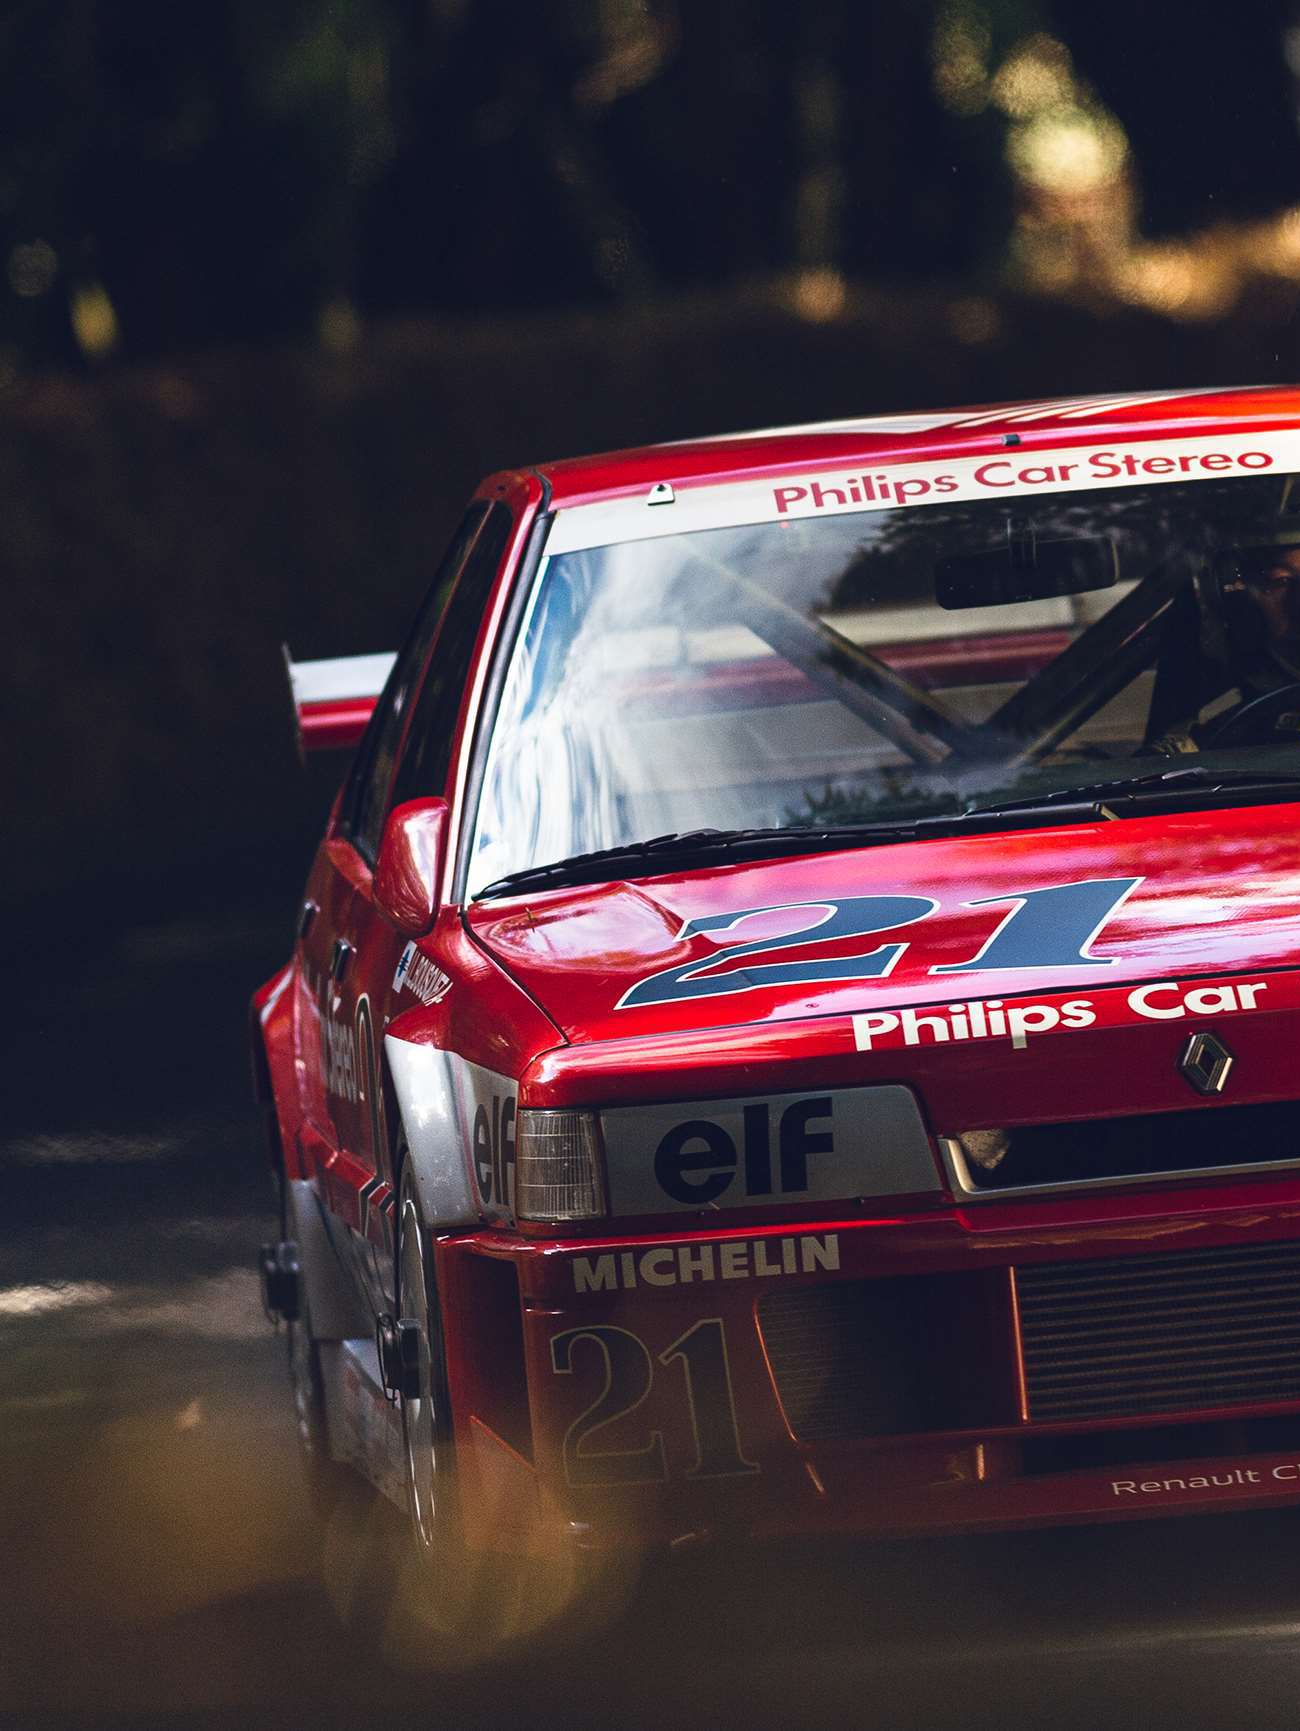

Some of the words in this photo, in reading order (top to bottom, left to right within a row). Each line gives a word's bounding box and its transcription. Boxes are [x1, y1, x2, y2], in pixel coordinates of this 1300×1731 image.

[772, 473, 957, 513] Philips
[973, 462, 1080, 489] Car
[1088, 450, 1275, 479] Stereo
[613, 876, 1146, 1011] 21
[852, 1000, 1096, 1052] Philips
[1127, 982, 1267, 1020] Car
[472, 1096, 516, 1206] elf
[654, 1097, 834, 1205] elf
[573, 1234, 840, 1293] MICHELIN
[550, 1317, 761, 1488] 21
[1112, 1469, 1260, 1495] Renault
